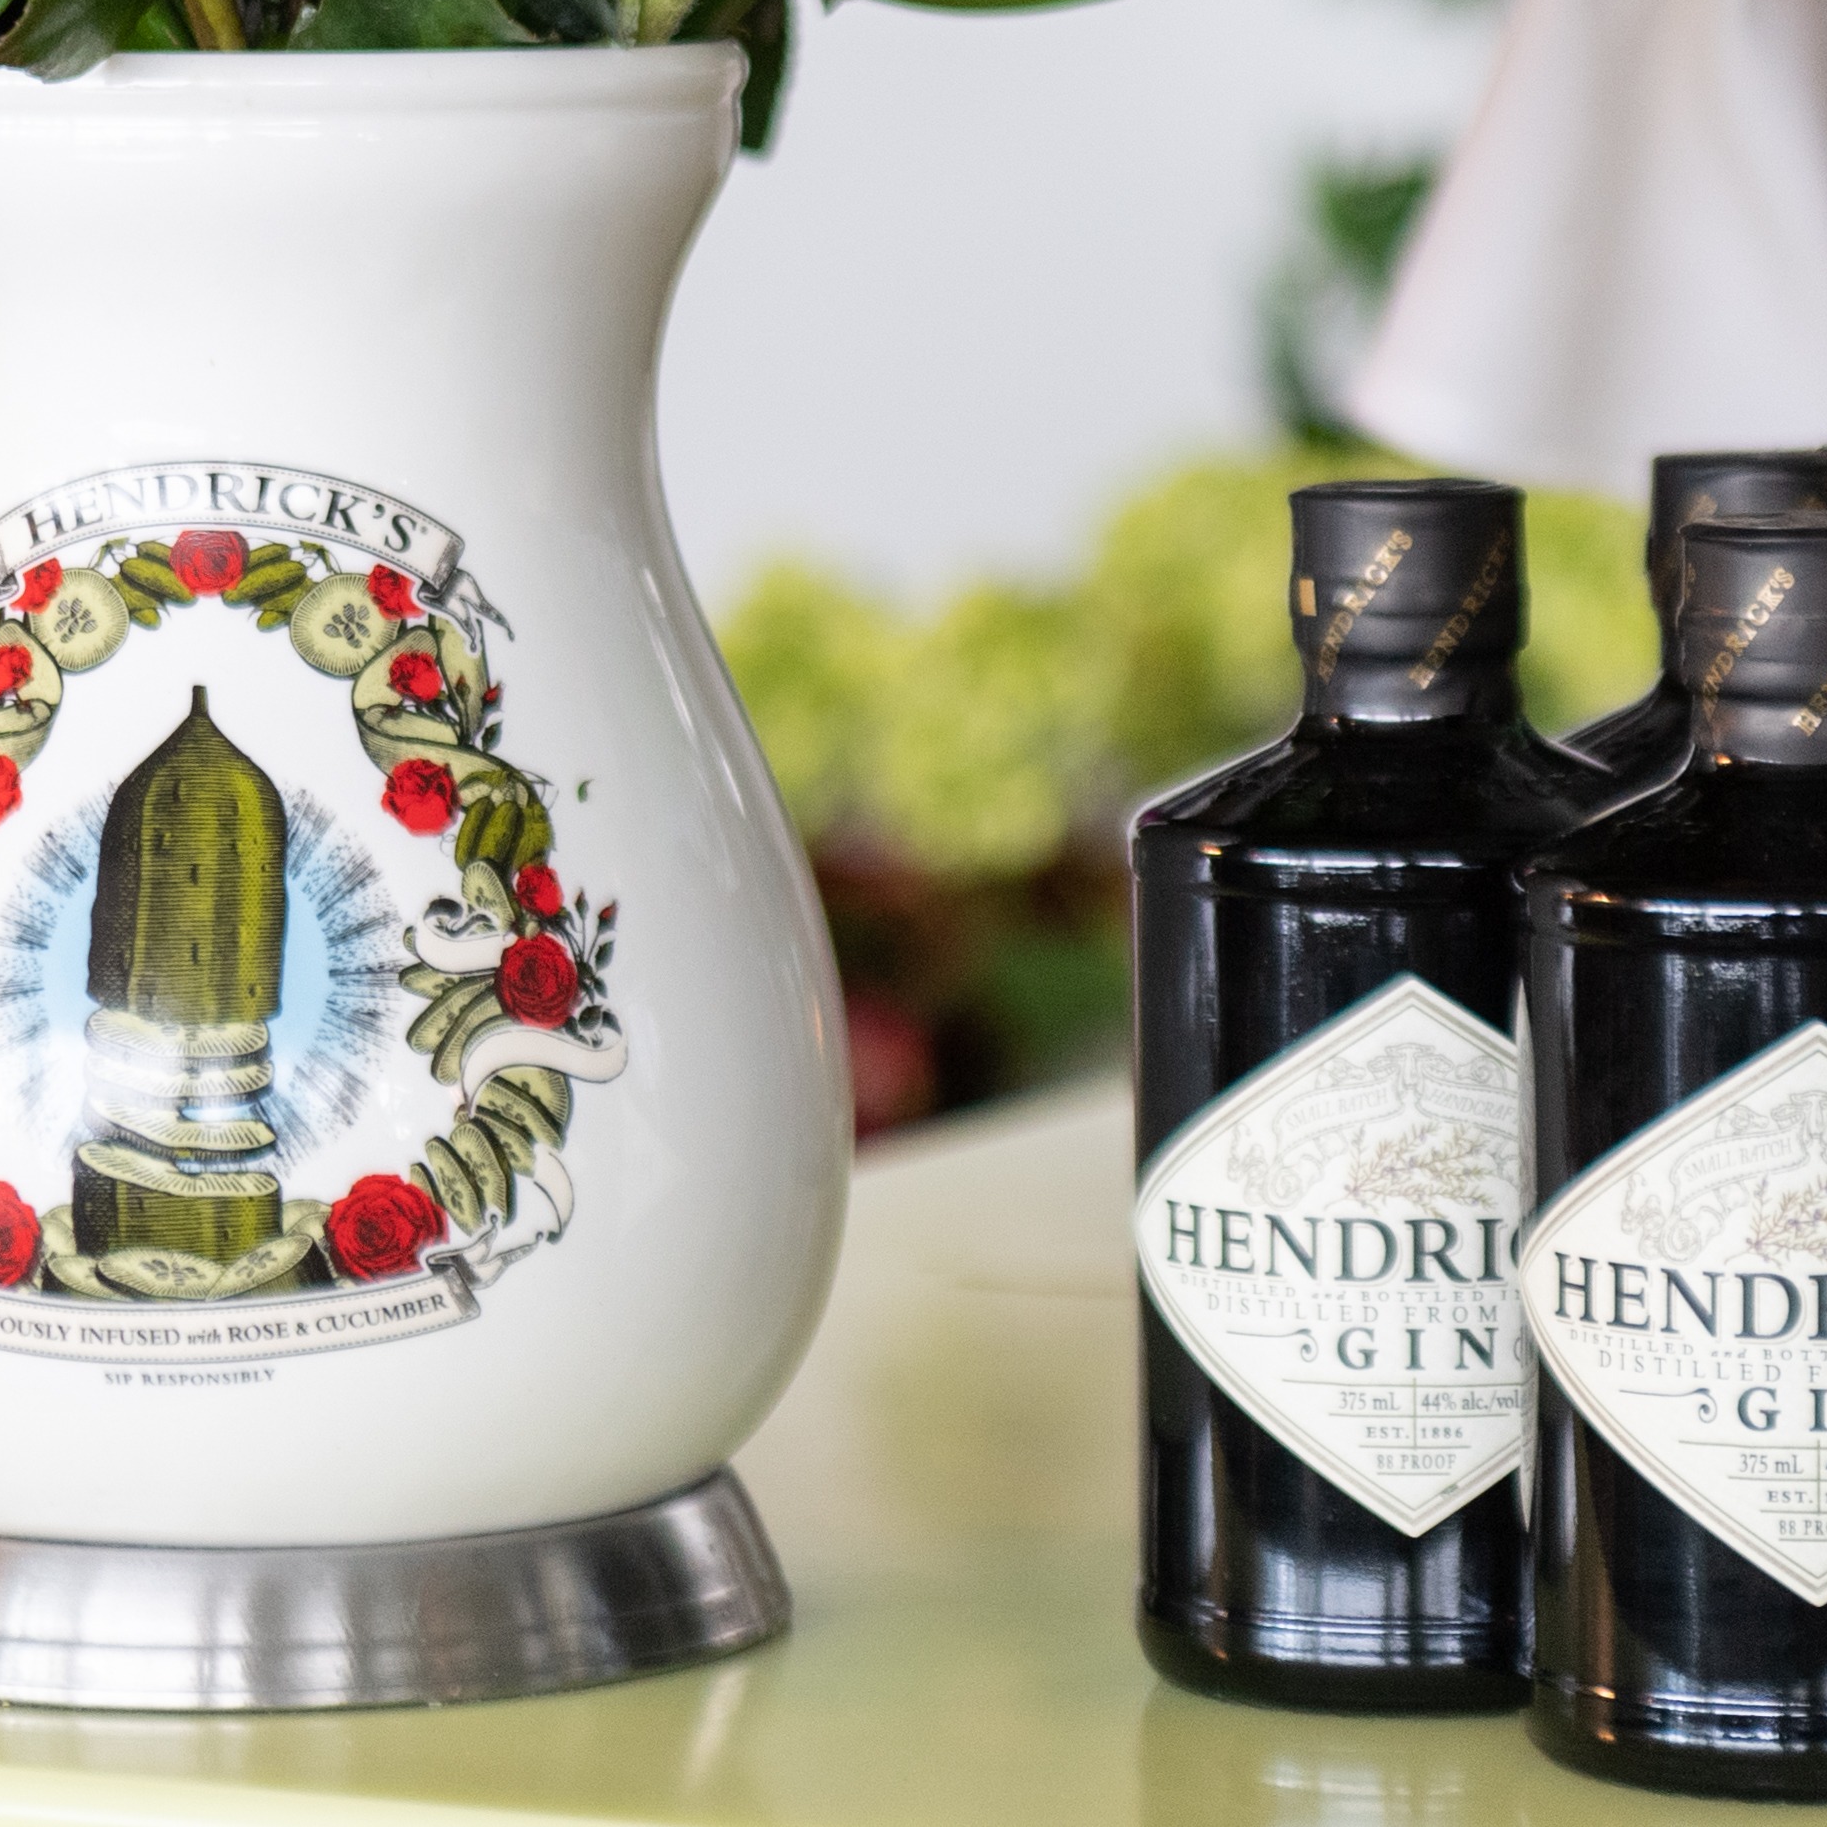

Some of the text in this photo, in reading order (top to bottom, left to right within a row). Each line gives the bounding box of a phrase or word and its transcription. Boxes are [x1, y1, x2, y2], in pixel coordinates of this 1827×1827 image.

[1165, 1199, 1519, 1284] HENDRI
[80, 1326, 181, 1346] INFUSED
[186, 1328, 222, 1345] with
[227, 1322, 291, 1344] ROSE
[295, 1321, 310, 1336] &
[315, 1293, 448, 1334] CUCUMBER
[1207, 1293, 1499, 1323] DISTILLED FROM
[1336, 1326, 1500, 1371] GIN
[1569, 1328, 1695, 1356] DISTILLED
[104, 1368, 276, 1387] SIP RESPONSIBLY
[1599, 1349, 1782, 1383] DISTILLED
[1338, 1390, 1519, 1413] 375 mL 44% alc./vol
[1365, 1426, 1464, 1439] EST. 1886
[1376, 1454, 1457, 1470] 88 PROOF
[1739, 1453, 1769, 1473] 375
[1774, 1454, 1804, 1474] mL
[1767, 1490, 1814, 1504] EST.
[1779, 1520, 1796, 1535] 88
